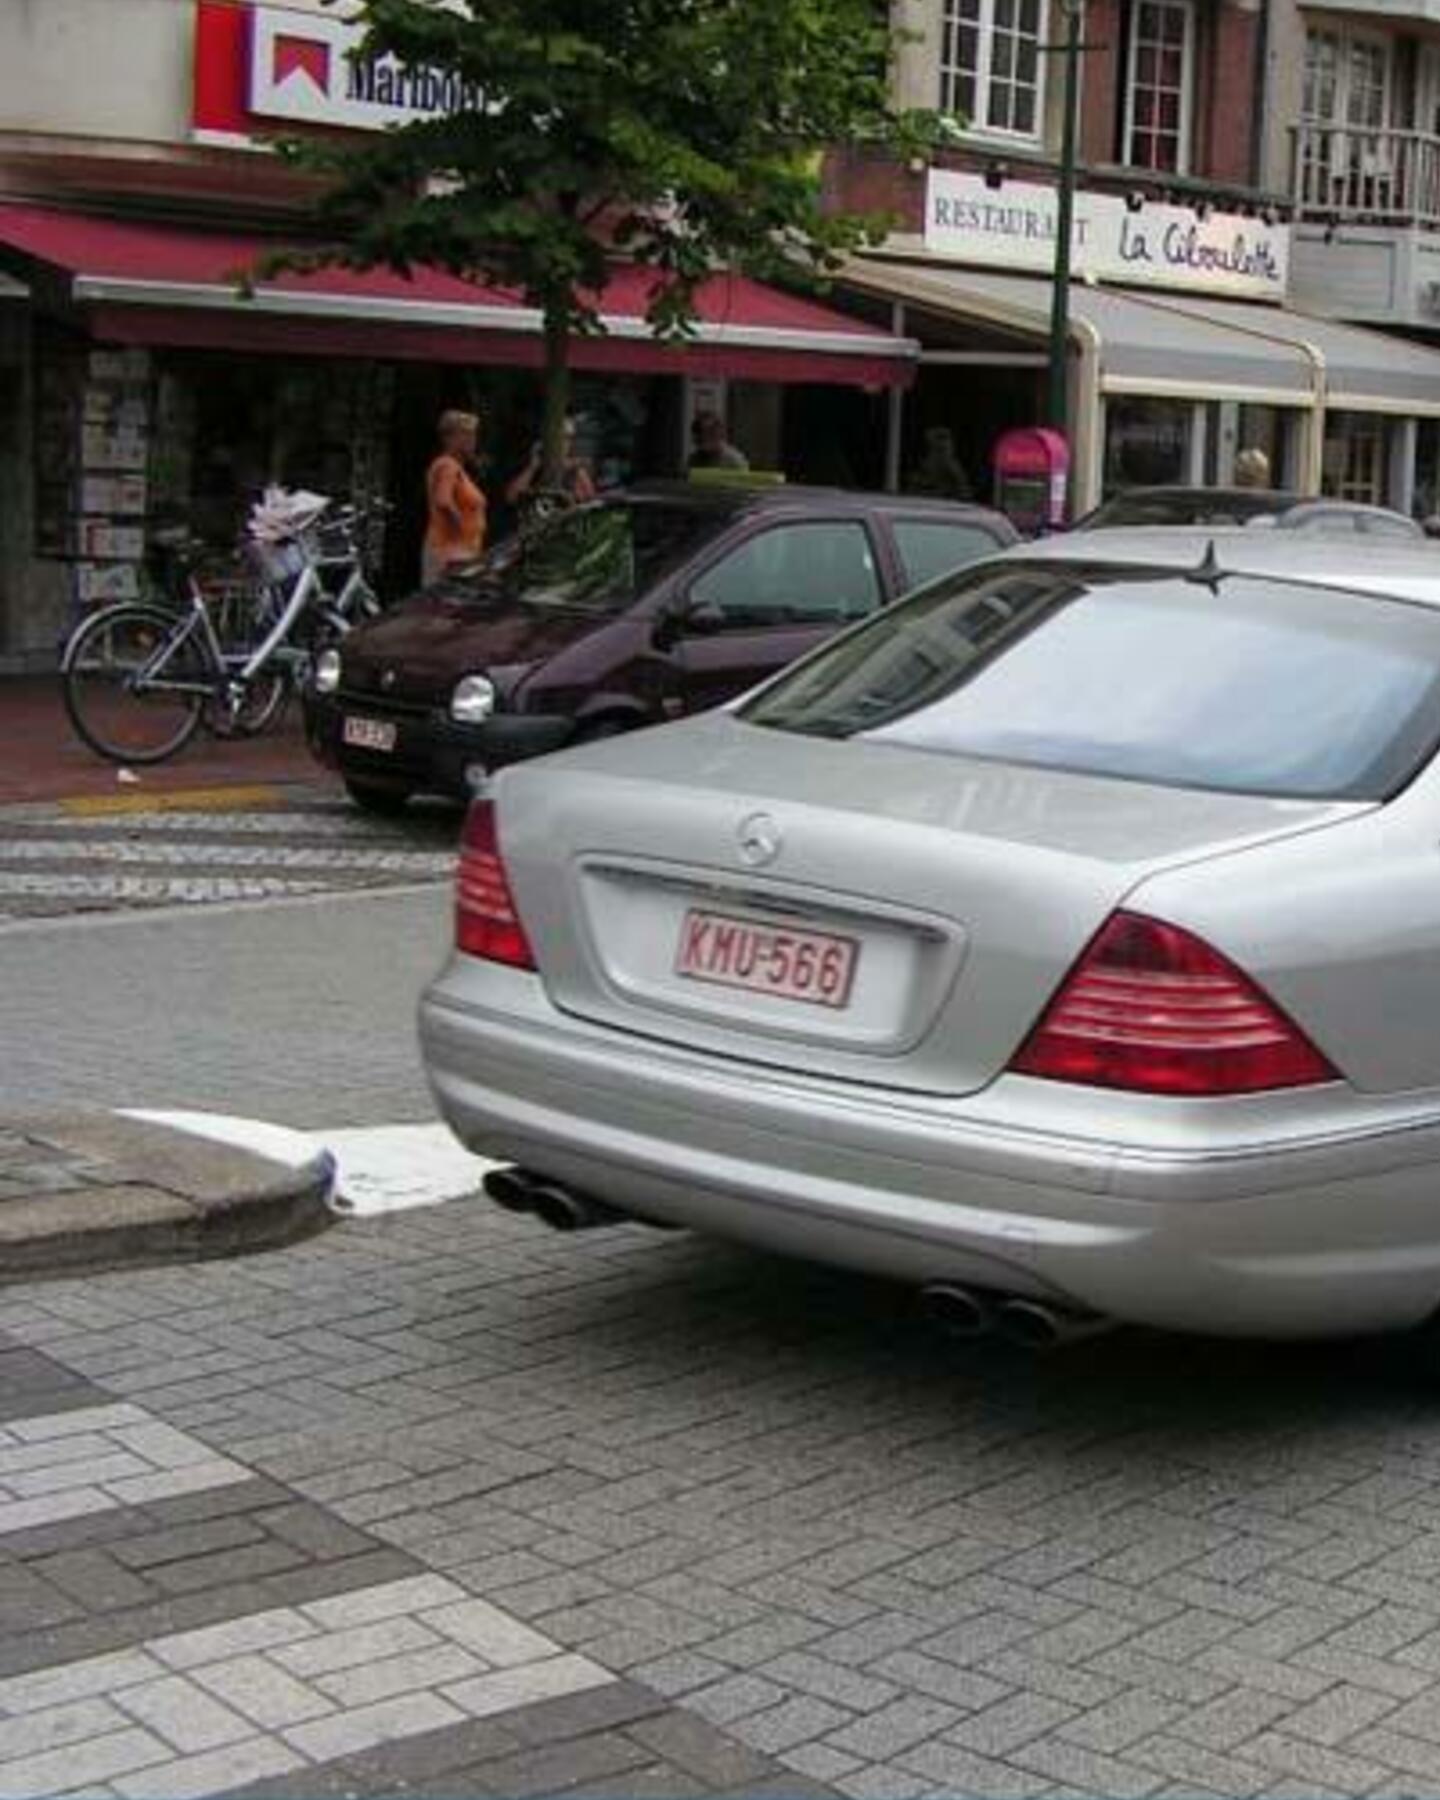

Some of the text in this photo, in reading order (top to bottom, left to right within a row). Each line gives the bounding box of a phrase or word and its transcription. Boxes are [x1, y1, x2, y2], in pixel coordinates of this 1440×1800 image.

[933, 197, 1090, 245] RESTAURAT
[1119, 217, 1152, 262] La
[685, 919, 843, 995] KMU-566
